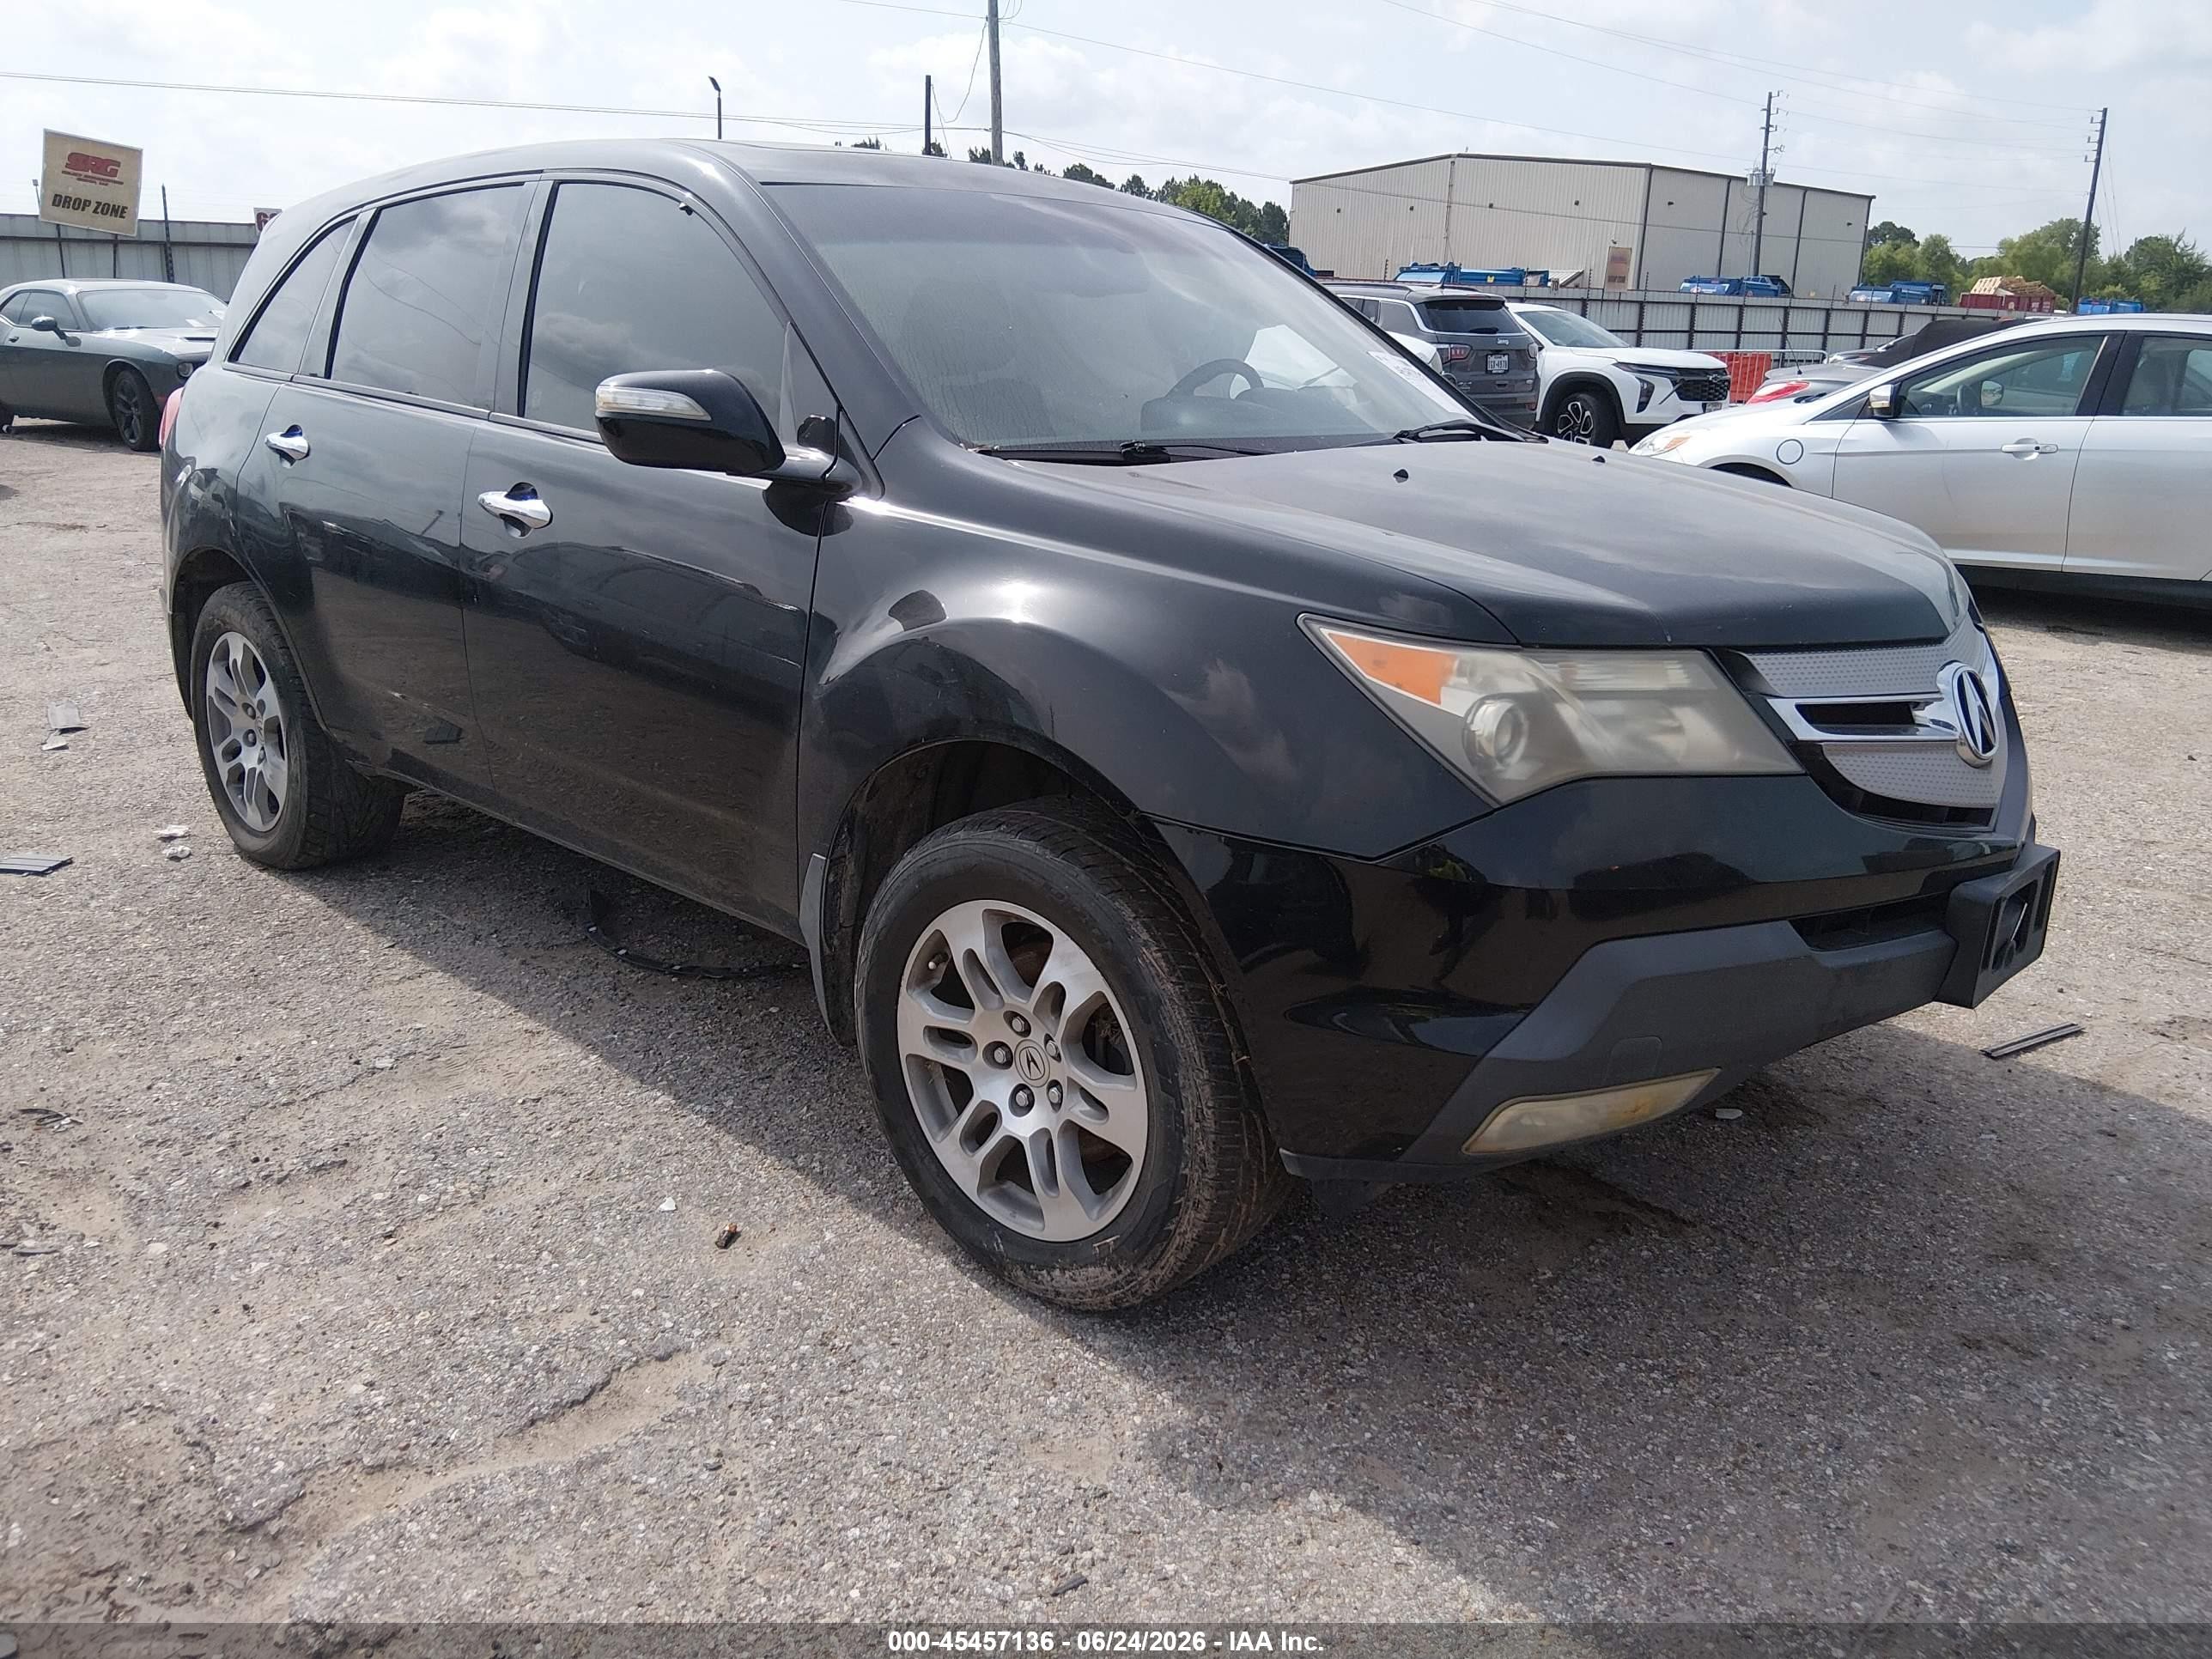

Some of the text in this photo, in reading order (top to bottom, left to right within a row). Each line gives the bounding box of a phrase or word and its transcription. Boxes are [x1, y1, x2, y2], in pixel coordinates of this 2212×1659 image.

[52, 193, 129, 219] DROP ZONE
[256, 211, 277, 233] 6
